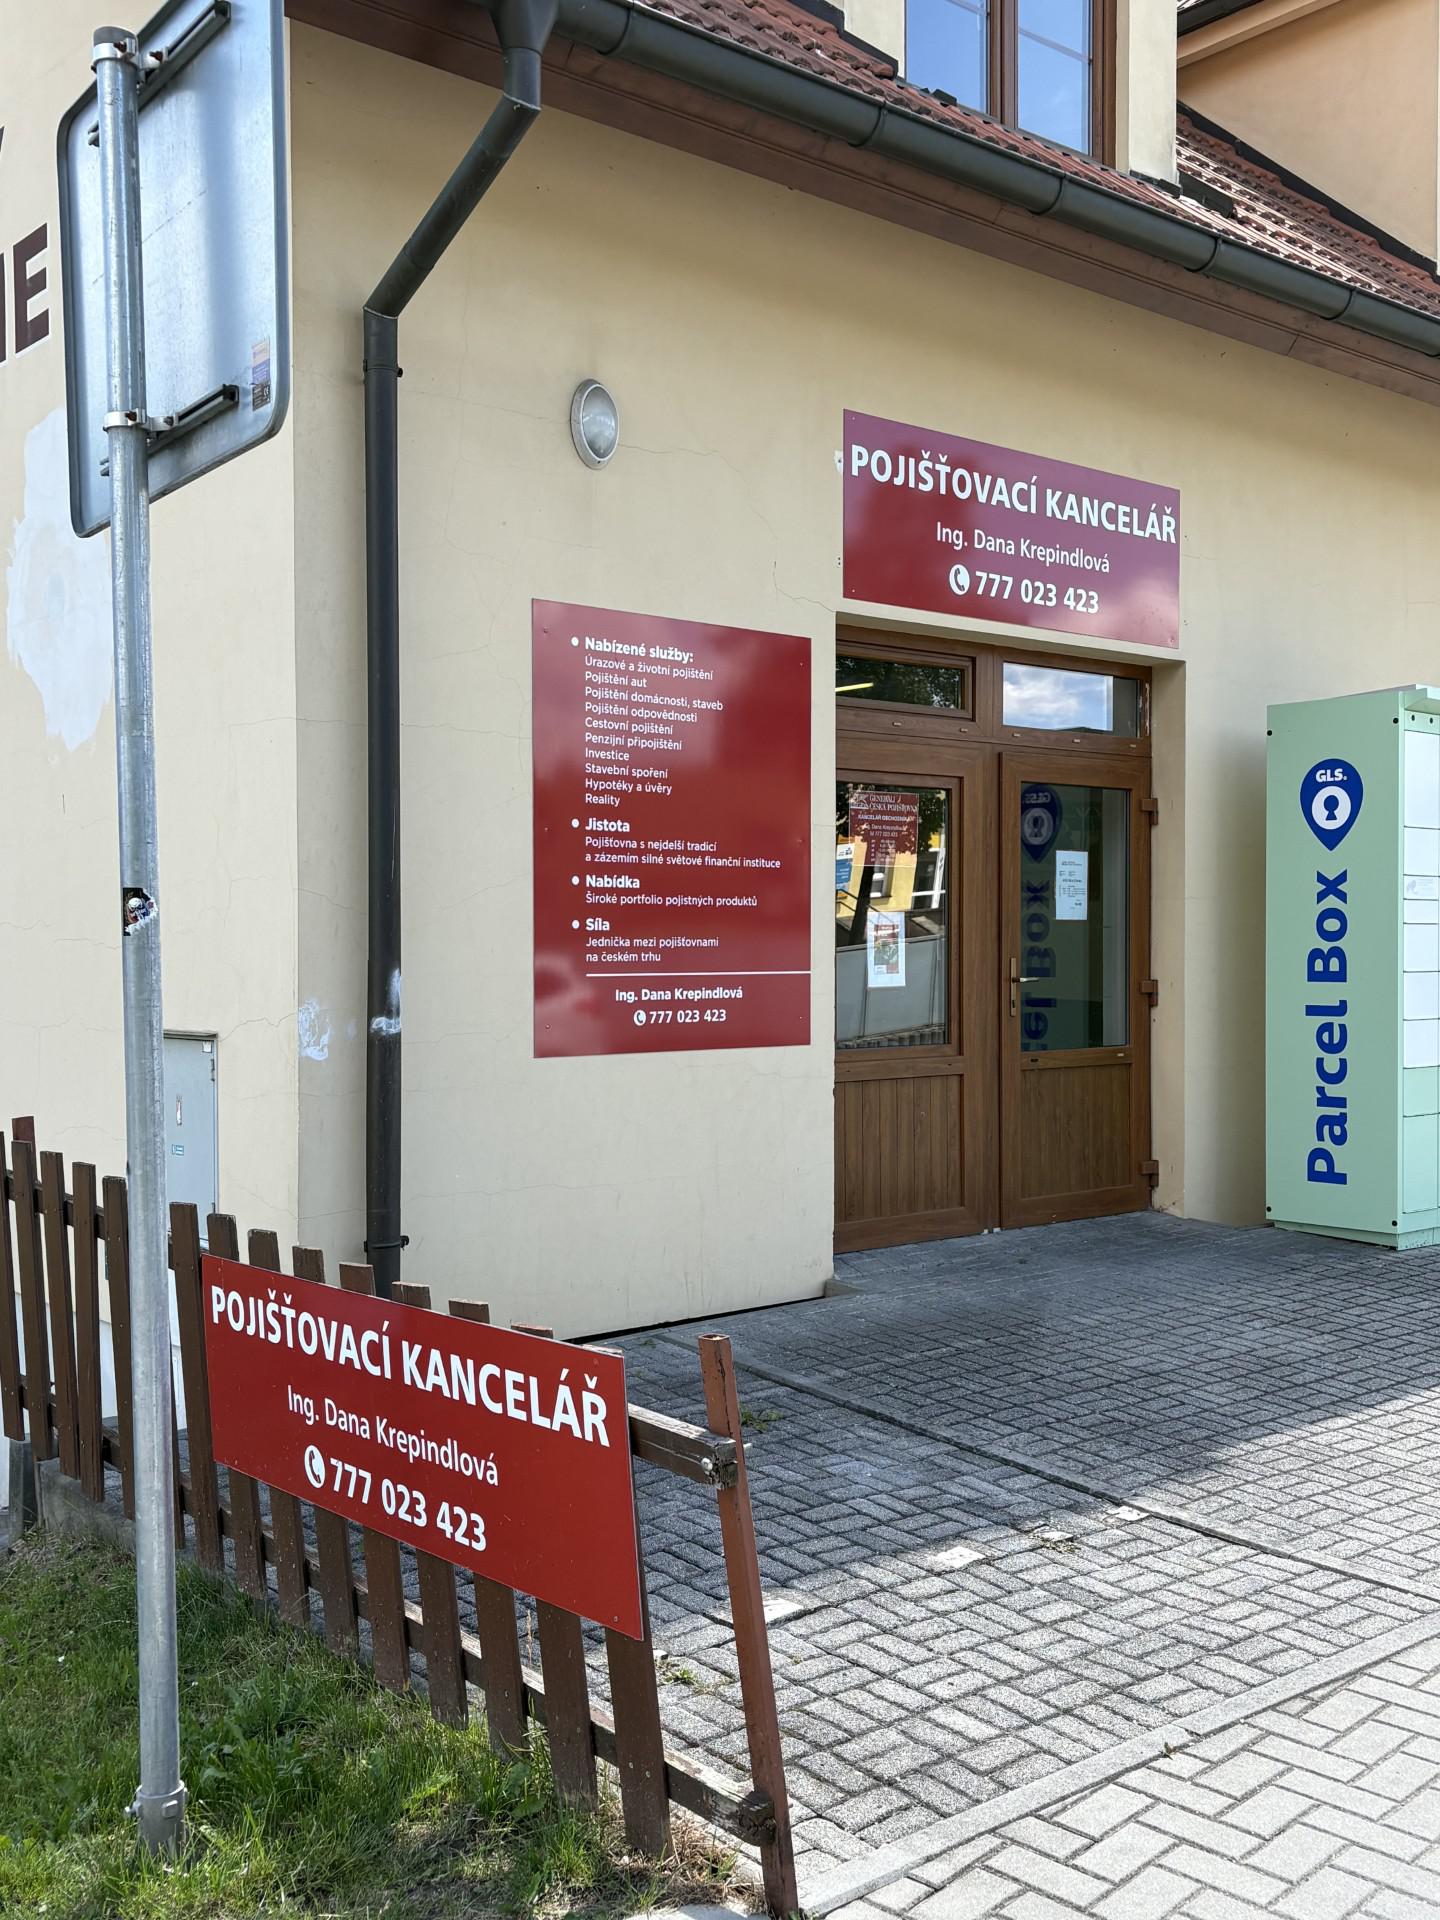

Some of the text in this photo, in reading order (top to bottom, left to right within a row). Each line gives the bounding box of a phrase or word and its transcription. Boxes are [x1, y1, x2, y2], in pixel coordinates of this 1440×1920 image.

[851, 444, 1177, 543] POJIŠŤOVACÍ KANCELÁŘ
[937, 522, 1110, 573] Ing. Dana Krepindlová
[975, 571, 1099, 614] 777 023 423
[585, 637, 694, 663] Nabízené služby:
[585, 654, 713, 680] Úrazové a životní pojištění
[585, 672, 647, 688] Pojištění aut
[585, 687, 723, 710] Pojištění domácnosti, staveb
[585, 702, 697, 722] Pojištění odpovědnosti
[585, 717, 673, 735] Cestovní pojištění
[585, 732, 682, 750] Penzijní připojištění
[585, 748, 629, 760] Investice
[585, 763, 668, 779] Stavební spoření
[585, 778, 672, 795] Hypotéky a úvěry
[585, 794, 620, 807] Reality
[585, 818, 630, 832] Jistota
[585, 837, 717, 852] Pojišťovna s nejdelší tradicí
[585, 852, 781, 868] a zázemím silné světové finanční instituce
[586, 875, 640, 889] Nabídka
[585, 891, 758, 907] Široké portfolio pojistných produktů
[585, 918, 610, 931] Síla
[586, 937, 719, 949] Jednička mezi pojišťovnami
[586, 952, 661, 962] na českém trhu
[615, 987, 742, 1003] Ing. Dana Krepindlová
[649, 1010, 726, 1024] 777 023 423
[1305, 868, 1348, 1185] Parcel Box
[211, 1285, 610, 1448] POJIŠŤOVACÍ KANCELÁŘ
[288, 1384, 499, 1486] Ing. Dana Krepindlová
[329, 1457, 487, 1552] 777 023 423
